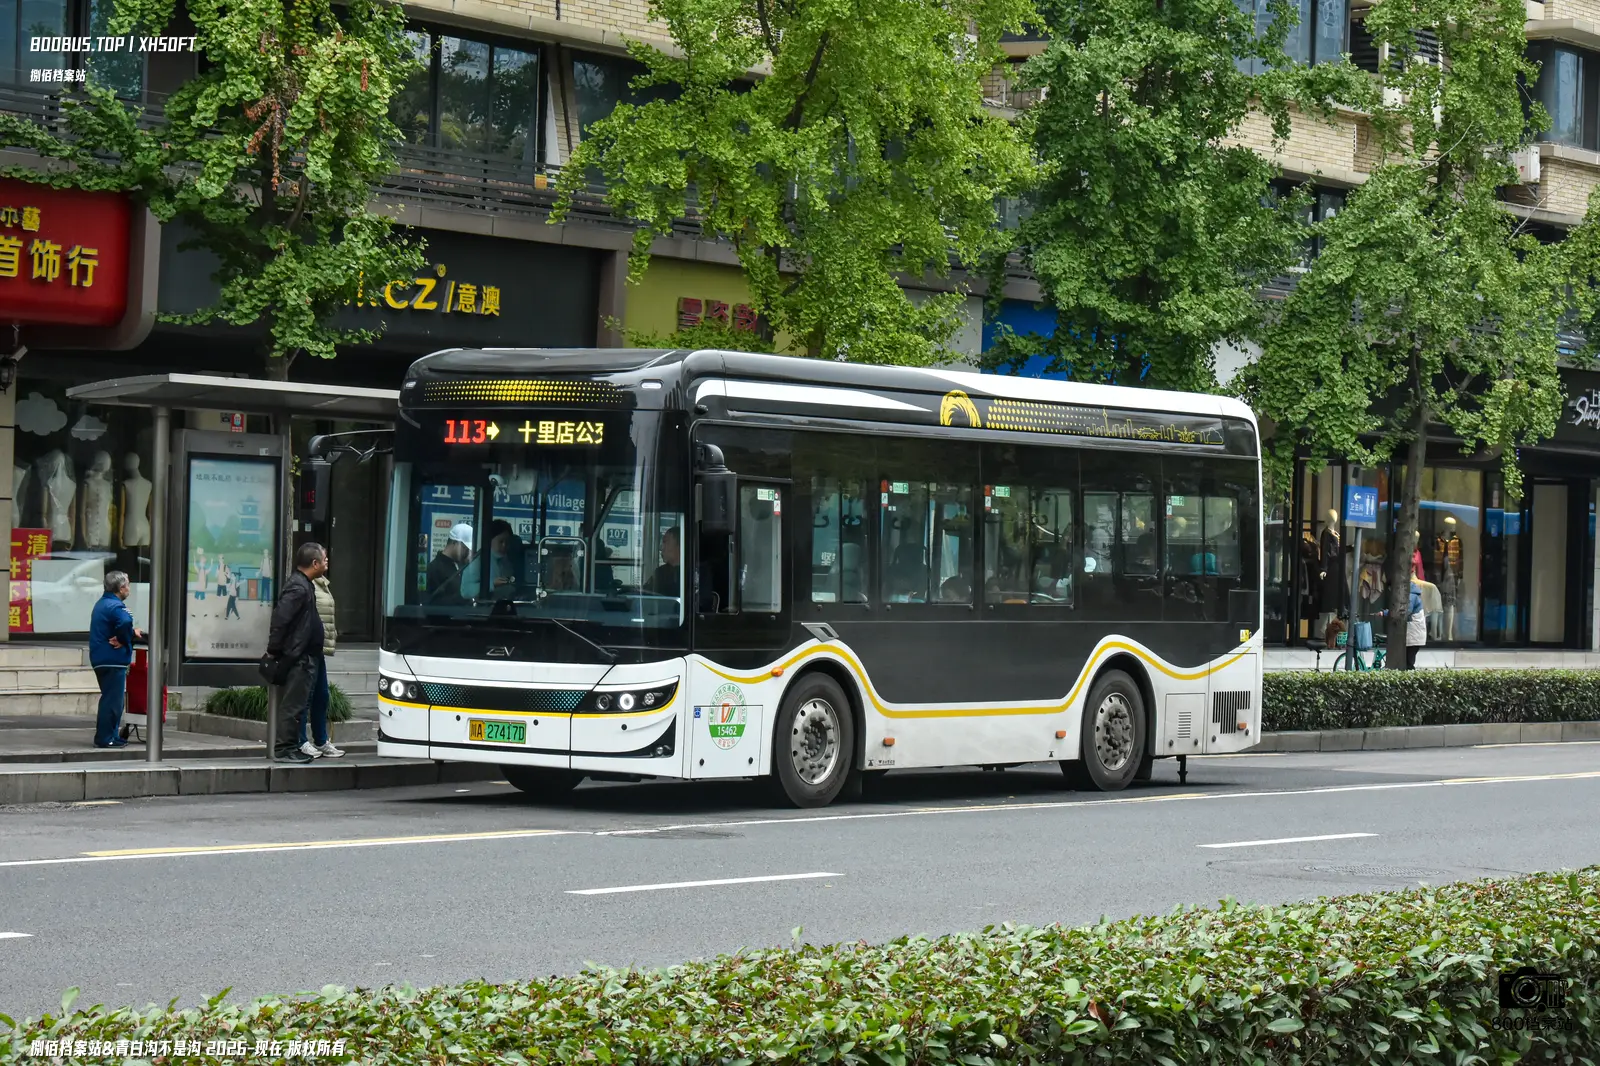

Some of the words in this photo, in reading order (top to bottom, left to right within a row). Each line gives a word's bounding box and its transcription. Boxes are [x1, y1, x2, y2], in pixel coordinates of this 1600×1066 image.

[457, 282, 501, 317] 意澳
[444, 419, 487, 443] 113
[547, 494, 585, 511] Village
[556, 525, 565, 536] 4
[608, 528, 627, 539] 107
[486, 724, 526, 742] 27417D
[717, 725, 738, 736] 15462
